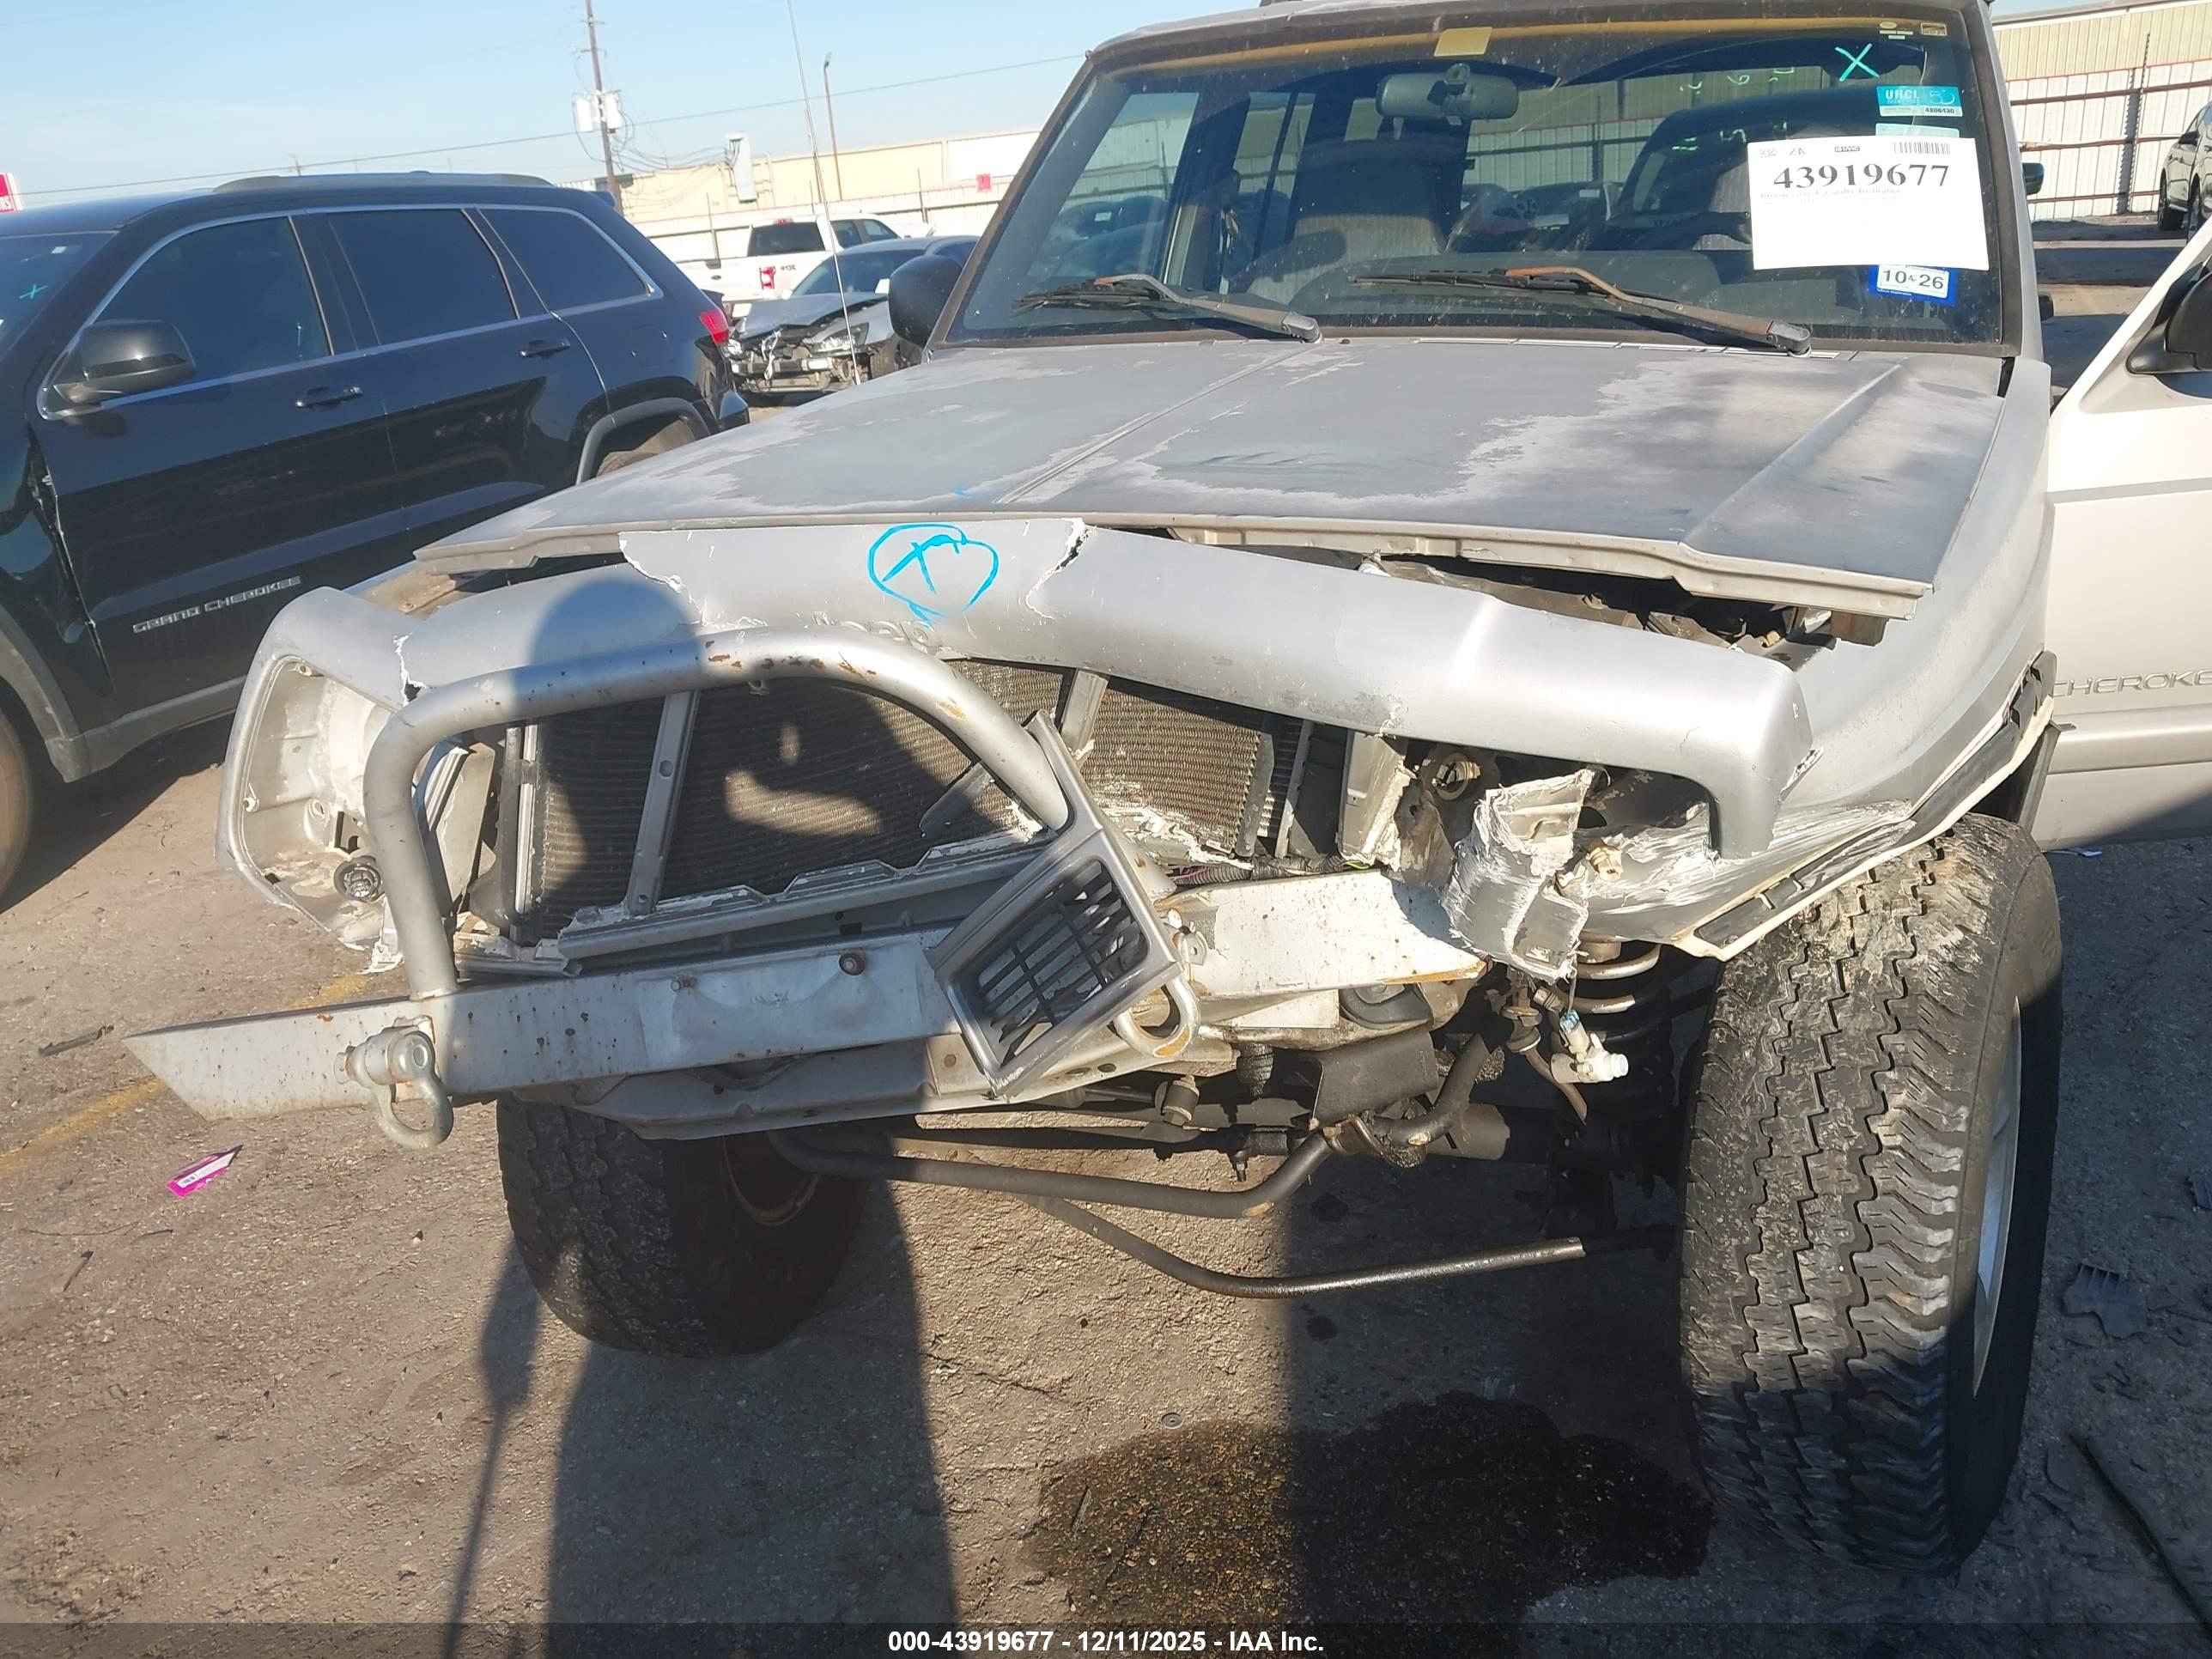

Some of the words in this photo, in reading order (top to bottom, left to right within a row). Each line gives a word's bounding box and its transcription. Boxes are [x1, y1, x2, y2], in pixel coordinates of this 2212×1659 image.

[1773, 163, 1949, 189] 43919677
[1883, 270, 1907, 284] 10
[1918, 274, 1944, 289] 26
[132, 605, 201, 633] GRAND
[204, 575, 301, 612] CHEROKEE
